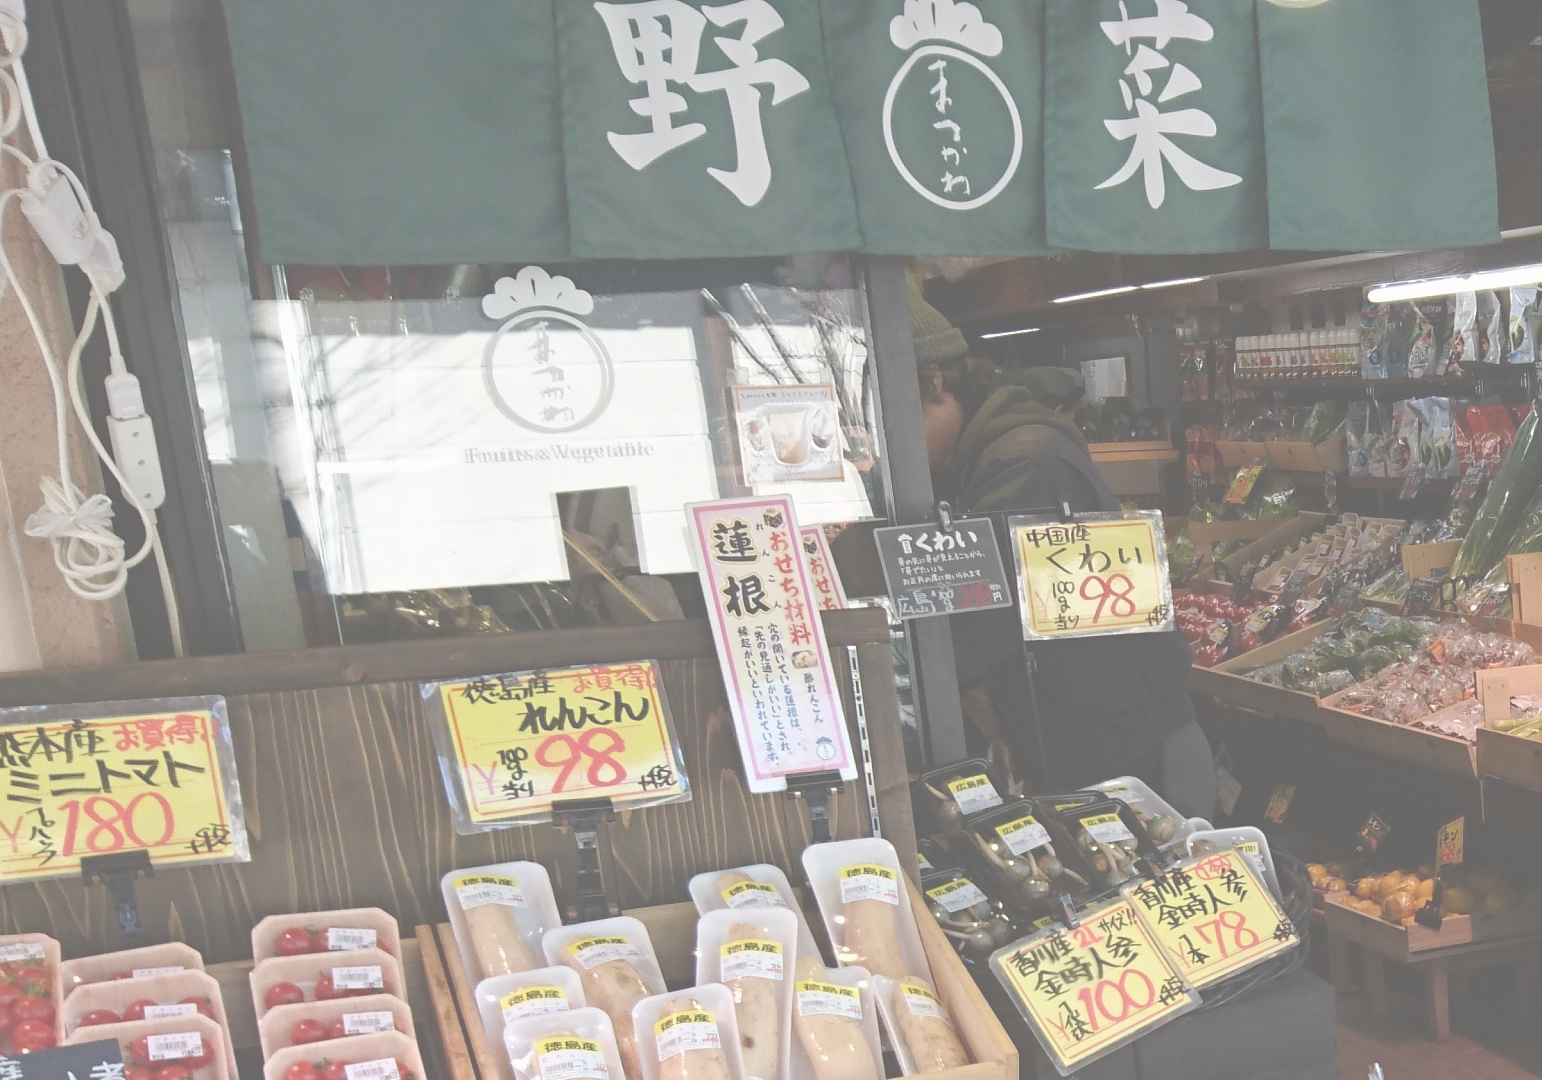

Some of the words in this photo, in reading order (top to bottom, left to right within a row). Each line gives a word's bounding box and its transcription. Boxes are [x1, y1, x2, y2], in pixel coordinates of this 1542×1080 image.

[595, 0, 811, 207] 野
[1093, 0, 1243, 209] 菜
[927, 59, 970, 197] まつかわ
[916, 530, 978, 553] くわい
[1025, 523, 1091, 548] 中国産
[712, 519, 772, 617] 蓮根
[1046, 543, 1143, 575] くわい
[770, 531, 812, 646] おせち材料
[1080, 572, 1137, 624] 98
[516, 690, 650, 735] れんこん
[7, 750, 205, 805] ミニトマト
[534, 727, 628, 794] 98
[57, 791, 176, 857] 180
[462, 875, 515, 887] 徳島産
[728, 882, 774, 897] 徳島産
[846, 867, 893, 880] 徳島産
[1157, 867, 1249, 931] 金時人参
[576, 936, 627, 951] 徳島産
[726, 941, 778, 955] 徳島産
[1193, 910, 1260, 959] 78
[803, 983, 855, 997] 徳島産
[1033, 934, 1142, 1002] 金時人参
[508, 989, 562, 1007] 徳島産
[1077, 968, 1156, 1033] 100
[660, 1013, 711, 1032] 徳島産
[543, 1039, 599, 1053] 徳島産
